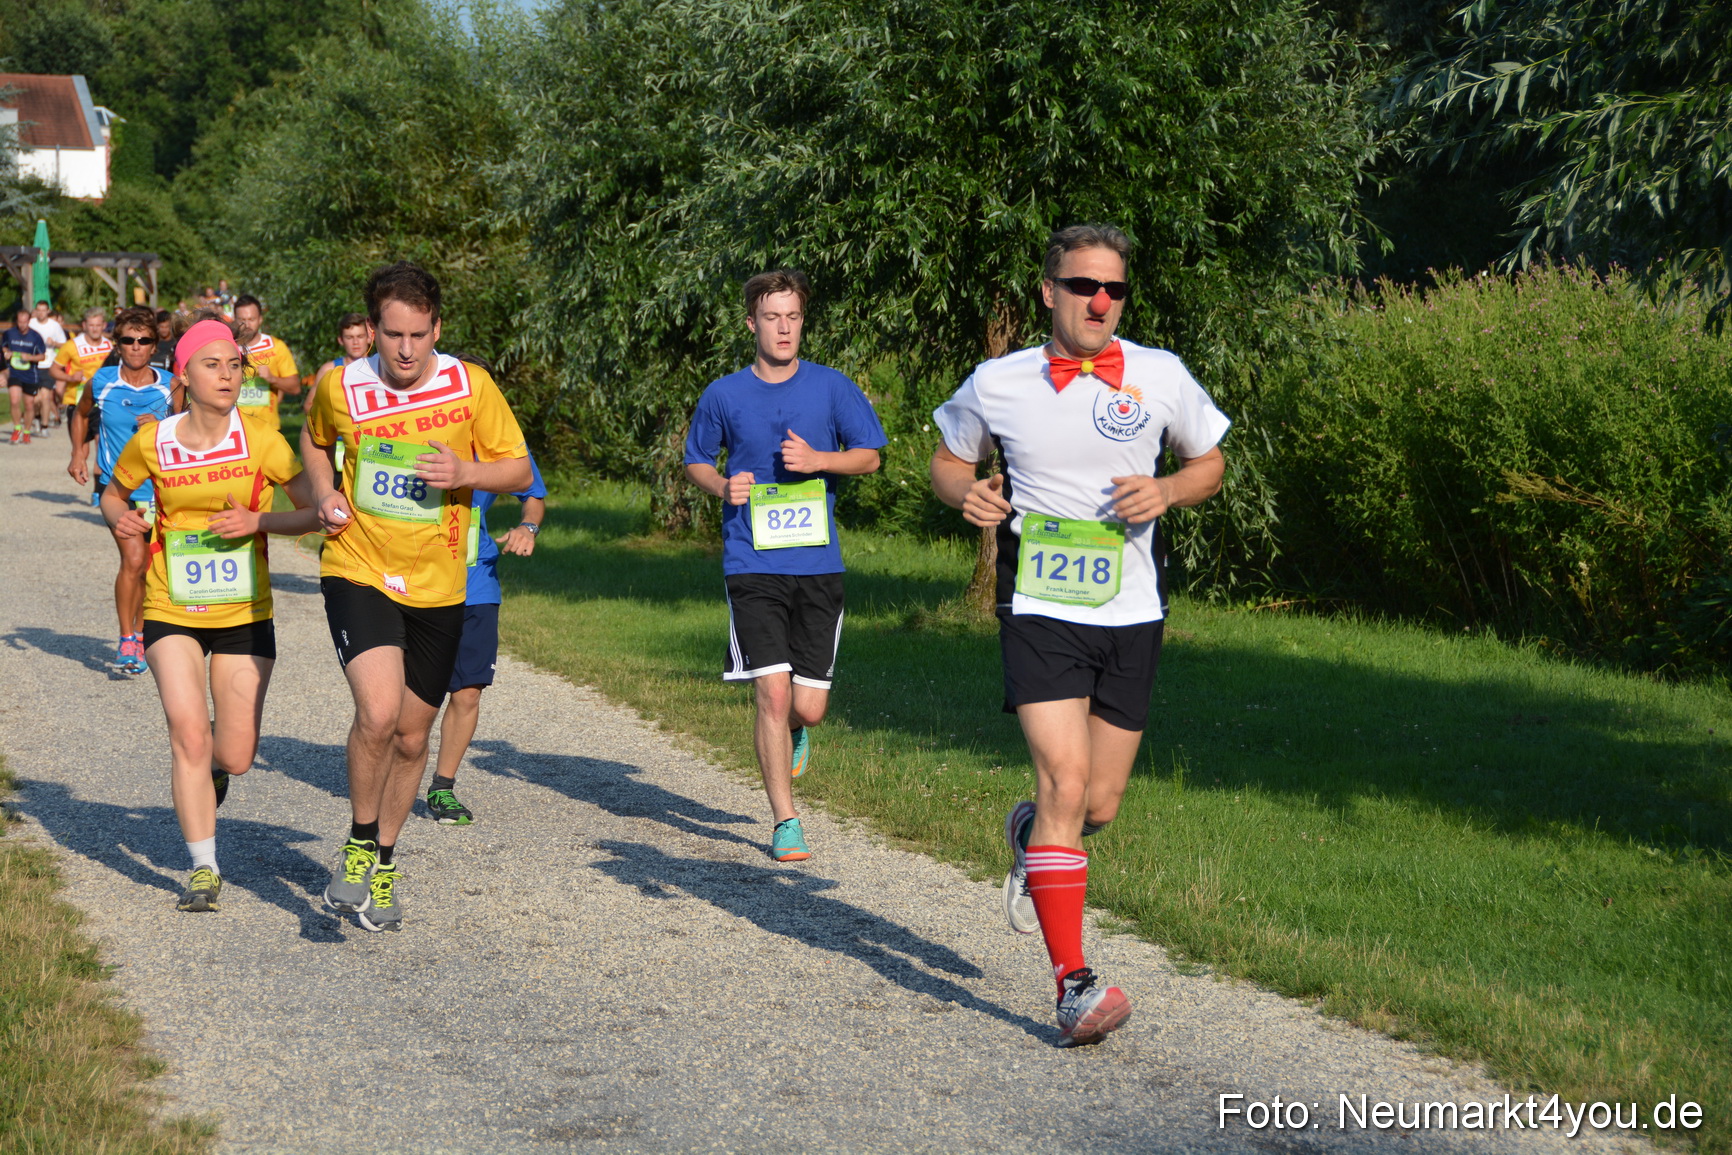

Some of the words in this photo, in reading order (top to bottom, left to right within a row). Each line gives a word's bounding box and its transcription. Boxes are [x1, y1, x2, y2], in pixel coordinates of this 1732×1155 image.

[241, 389, 263, 399] 950
[415, 405, 472, 432] BÖGL
[161, 473, 202, 488] MAX
[207, 465, 254, 482] BÖGL
[372, 470, 428, 502] 888
[381, 501, 400, 509] Stefan
[399, 503, 414, 511] Grad
[767, 506, 813, 530] 822
[1037, 529, 1072, 539] firmenlauf
[185, 558, 238, 584] 919
[1030, 550, 1111, 584] 1218
[1045, 585, 1063, 593] Frank
[1064, 587, 1090, 595] Langner
